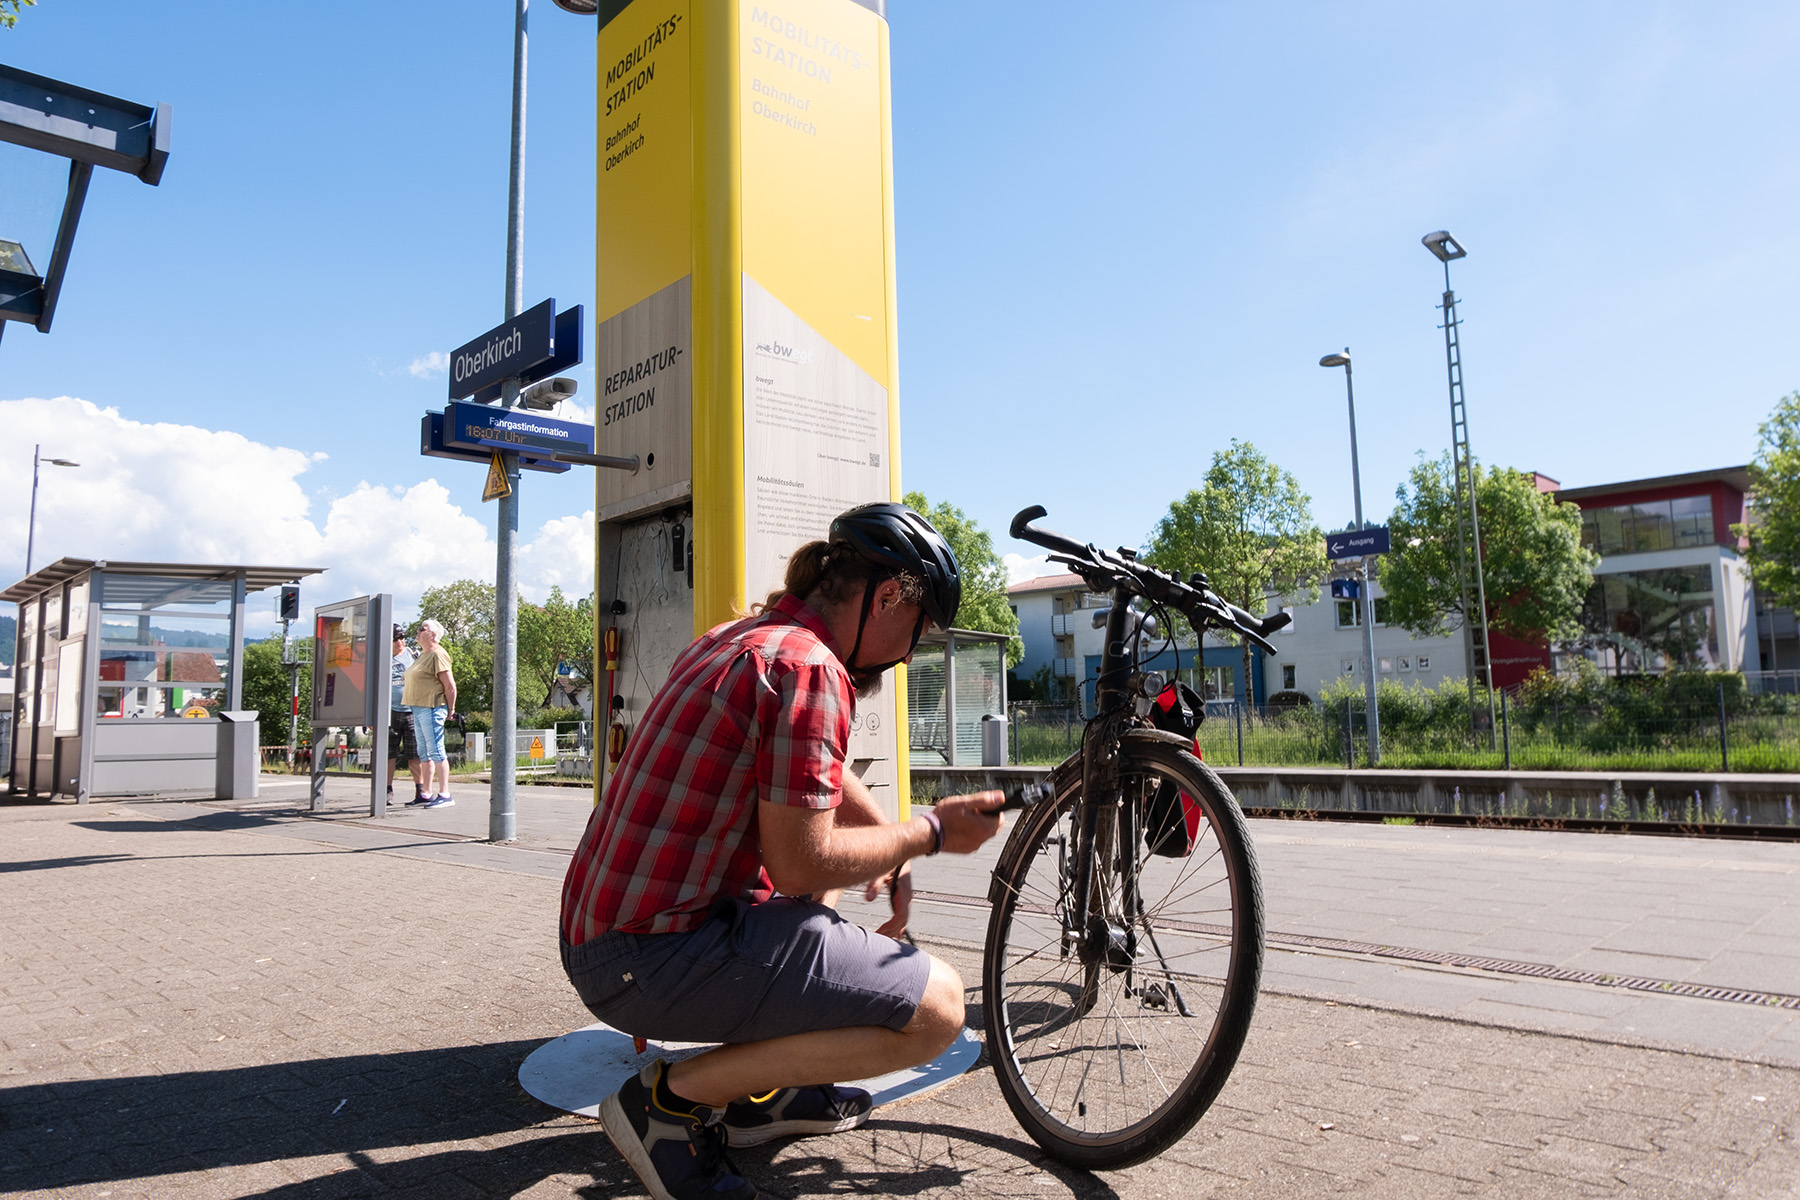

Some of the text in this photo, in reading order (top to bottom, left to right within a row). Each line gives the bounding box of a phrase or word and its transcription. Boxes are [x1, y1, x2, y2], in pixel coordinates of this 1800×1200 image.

[605, 13, 683, 89] MOBILITÄTS-
[751, 6, 870, 70] MOBILITÄTS-
[751, 36, 832, 85] STATION
[605, 62, 656, 117] STATION
[751, 77, 811, 112] Bahnhof
[605, 113, 641, 152] Bahnhof
[752, 100, 817, 136] Oberkirch
[605, 134, 645, 172] Oberkirch
[454, 326, 522, 384] Oberkirch
[604, 345, 683, 397] REPARATUR-
[604, 386, 656, 426] STATION
[465, 423, 528, 445] 16:07 Uhr
[488, 416, 569, 438] Fahrgastinformation
[1348, 536, 1375, 547] Ausgang
